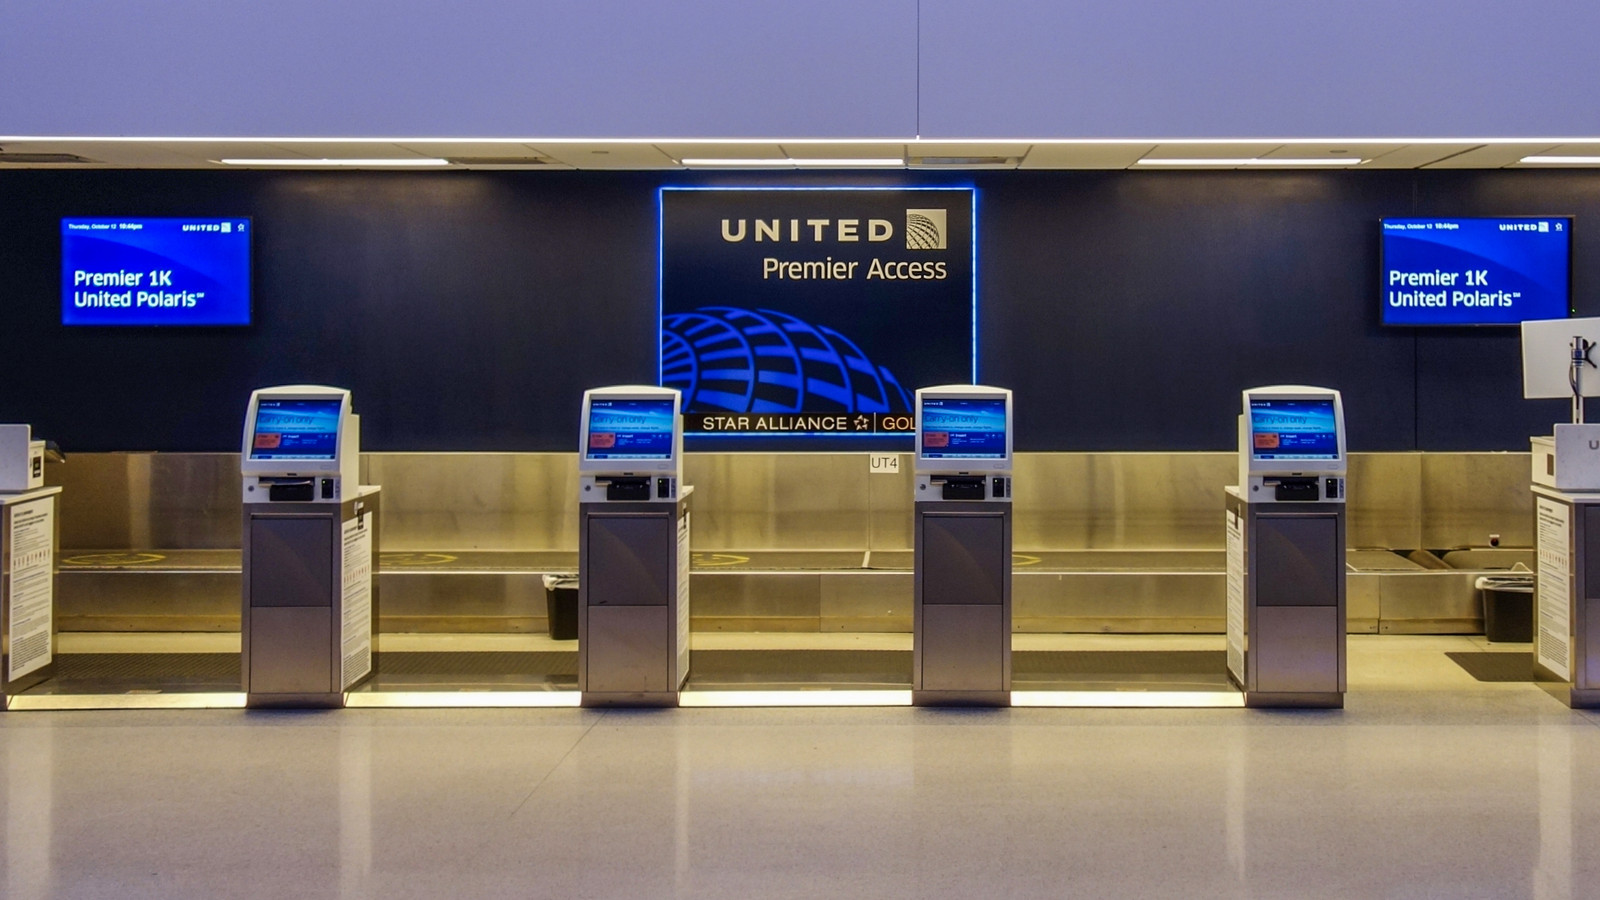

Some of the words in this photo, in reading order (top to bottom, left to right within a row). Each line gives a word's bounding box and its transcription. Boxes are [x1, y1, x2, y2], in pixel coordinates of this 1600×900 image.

[182, 224, 220, 232] UNITED
[721, 219, 894, 242] UNITED
[1384, 223, 1406, 231] Thursday,
[1499, 223, 1538, 231] UNITED
[763, 257, 858, 280] Premier
[866, 258, 947, 280] Access
[74, 270, 144, 287] Premier
[149, 270, 172, 287] 1K
[1389, 269, 1459, 286] Premier
[1465, 269, 1488, 286] 1K
[74, 290, 132, 308] United
[1389, 290, 1447, 307] United
[296, 415, 314, 425] only
[629, 415, 647, 424] only
[702, 416, 750, 431] STAR
[755, 416, 848, 431] ALLIANCE
[961, 415, 979, 424] only
[1291, 415, 1307, 424] only
[871, 457, 898, 469] UT4
